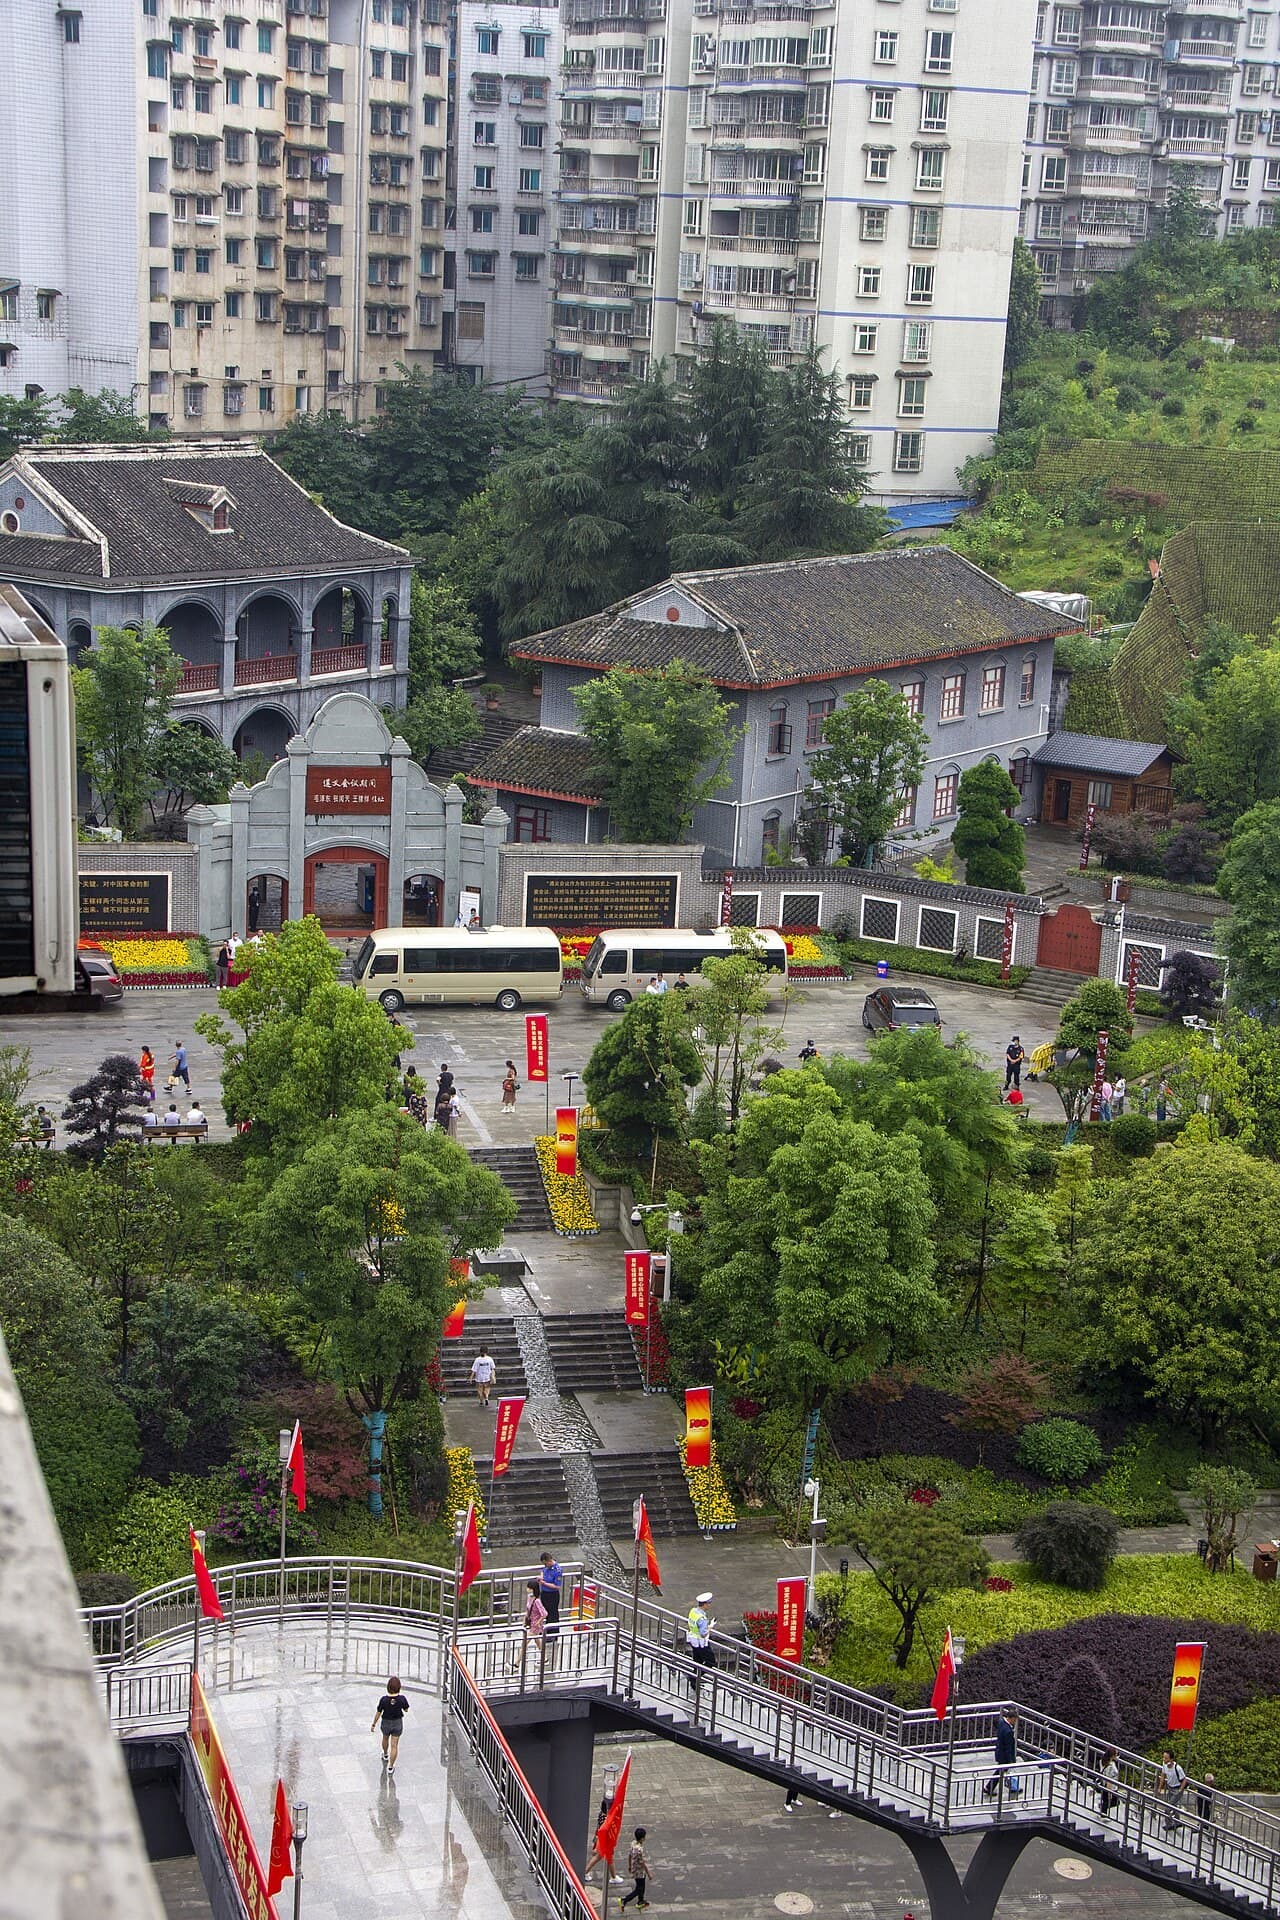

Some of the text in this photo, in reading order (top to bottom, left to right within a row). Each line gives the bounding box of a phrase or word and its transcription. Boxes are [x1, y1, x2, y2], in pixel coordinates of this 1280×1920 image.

[323, 779, 376, 788] 遵义会议期间
[79, 880, 150, 888] 关键，对中国革命的影
